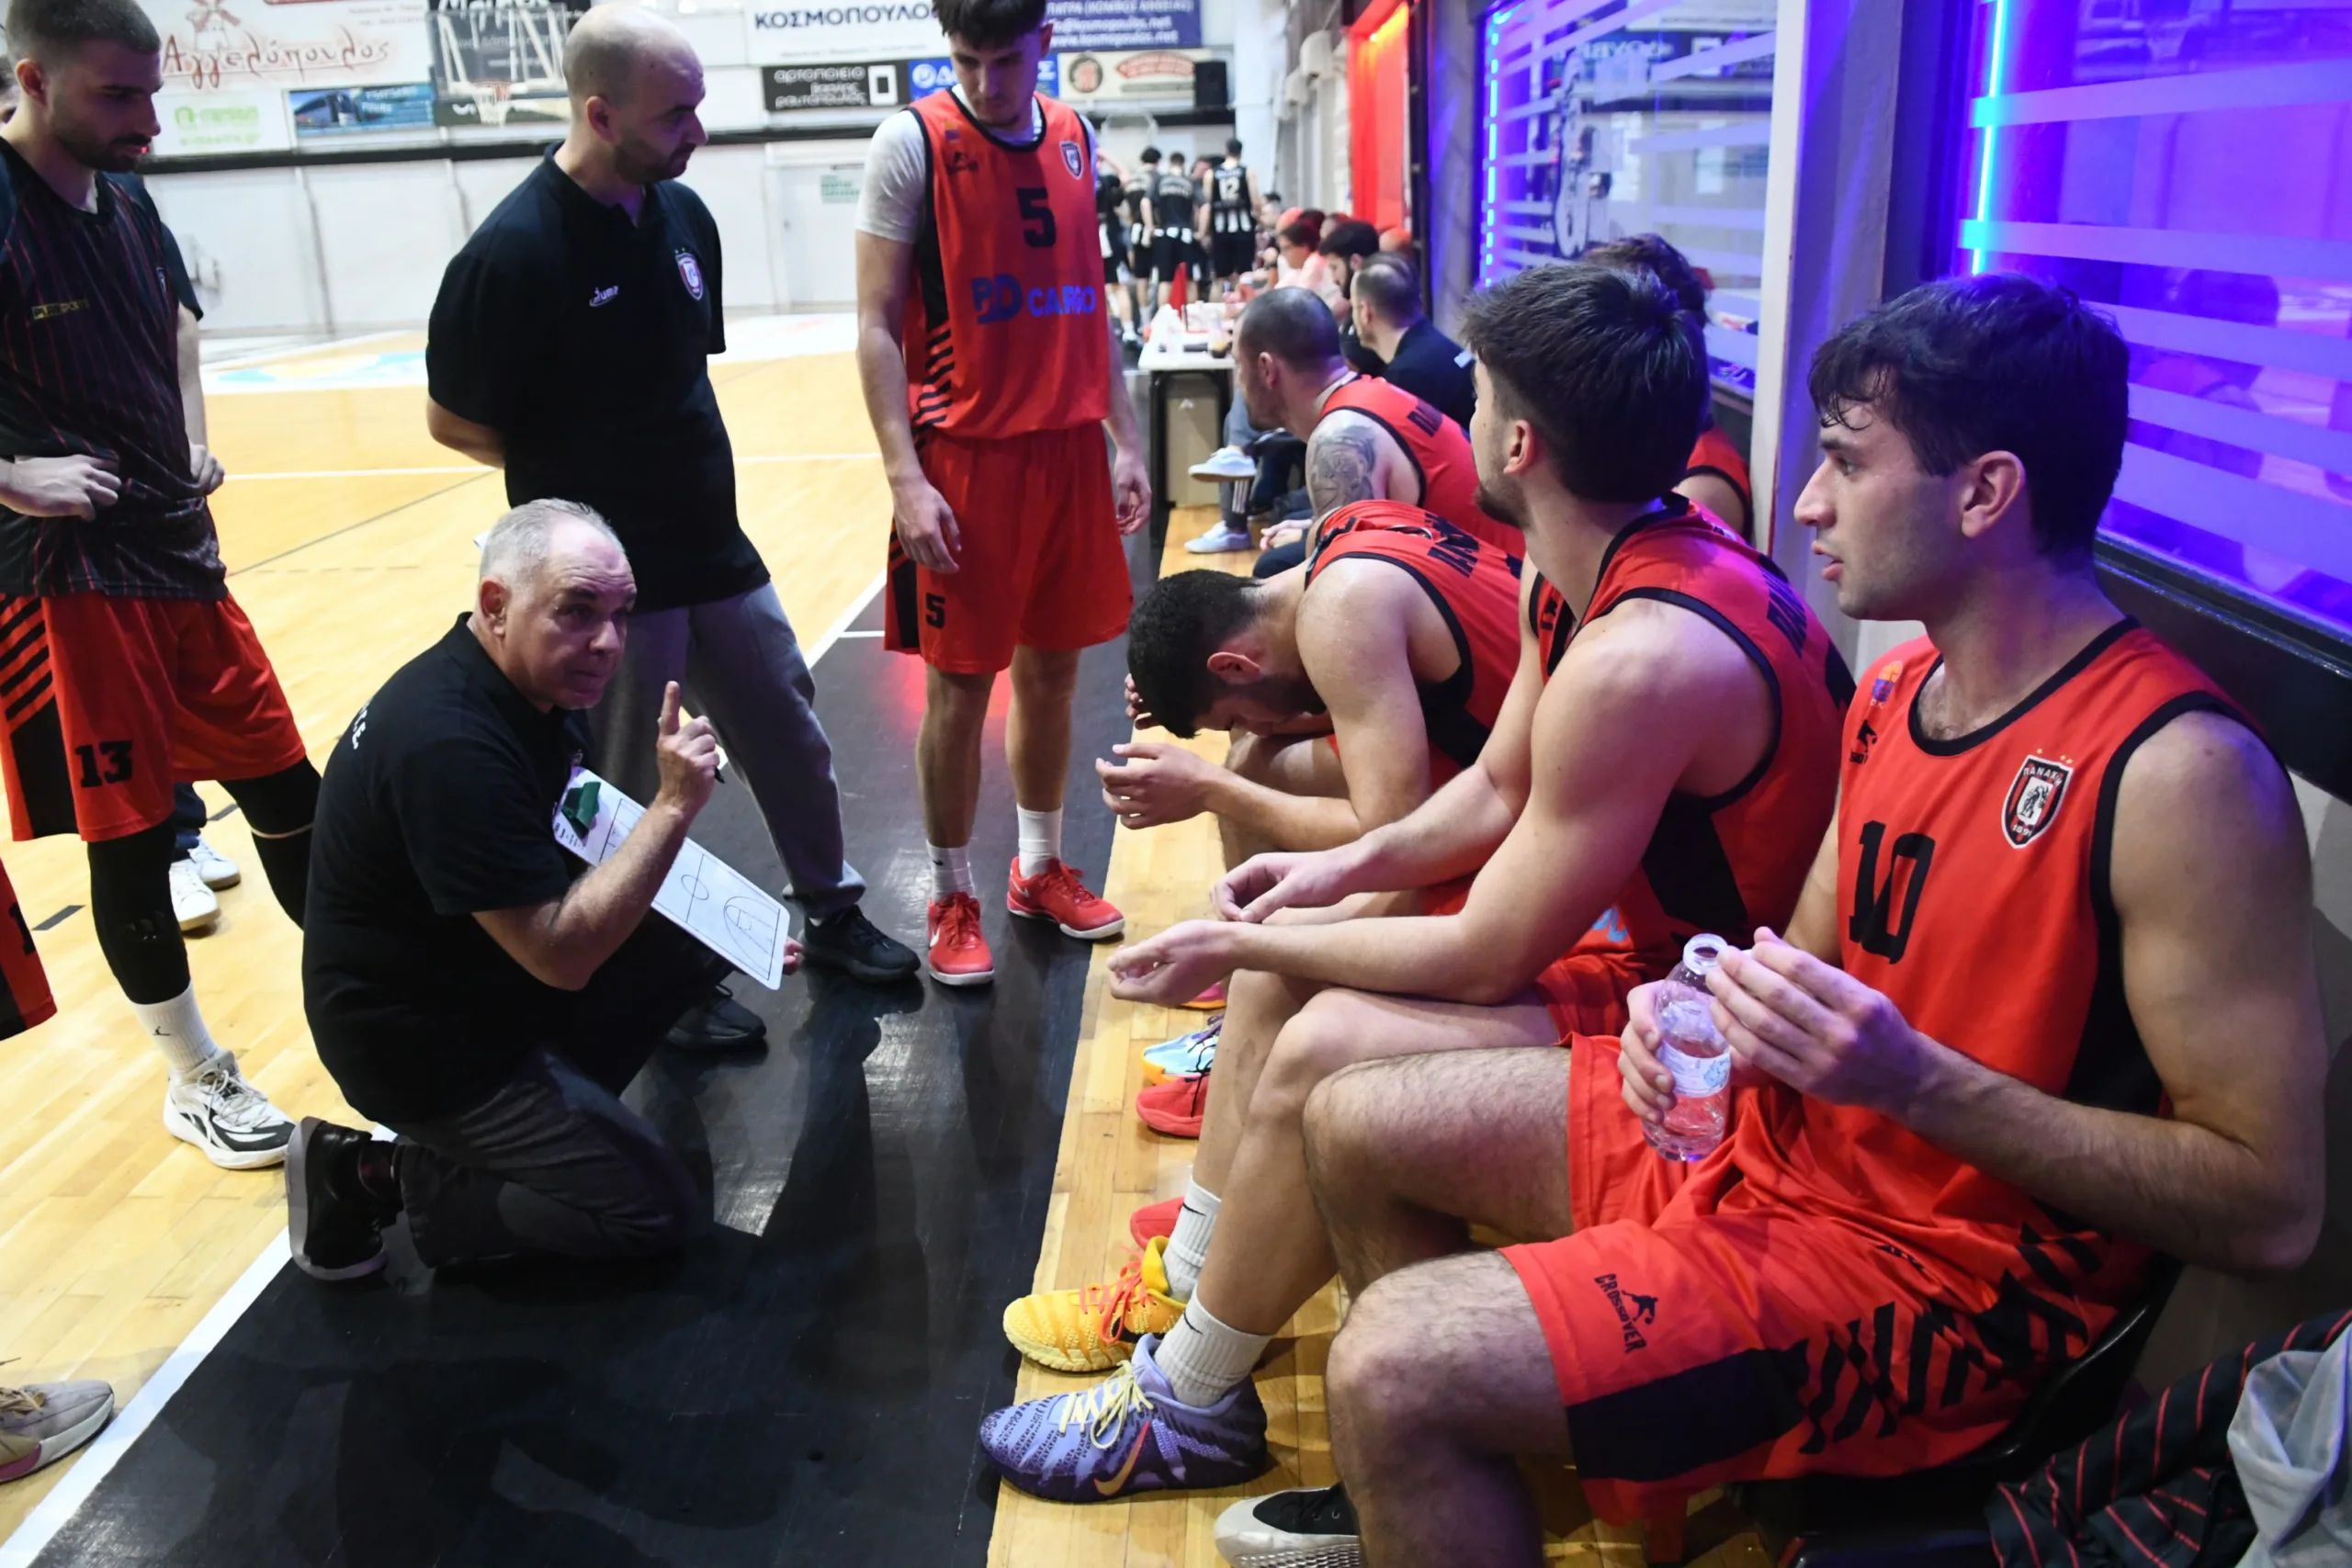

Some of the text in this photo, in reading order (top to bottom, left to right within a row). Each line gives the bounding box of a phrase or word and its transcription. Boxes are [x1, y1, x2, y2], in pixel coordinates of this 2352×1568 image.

[1016, 186, 1057, 248] 5
[1027, 285, 1097, 317] CARGO
[925, 592, 946, 629] 5
[75, 740, 133, 788] 13
[1849, 820, 1936, 964] 10
[1594, 1273, 1647, 1355] CROSSOVER
